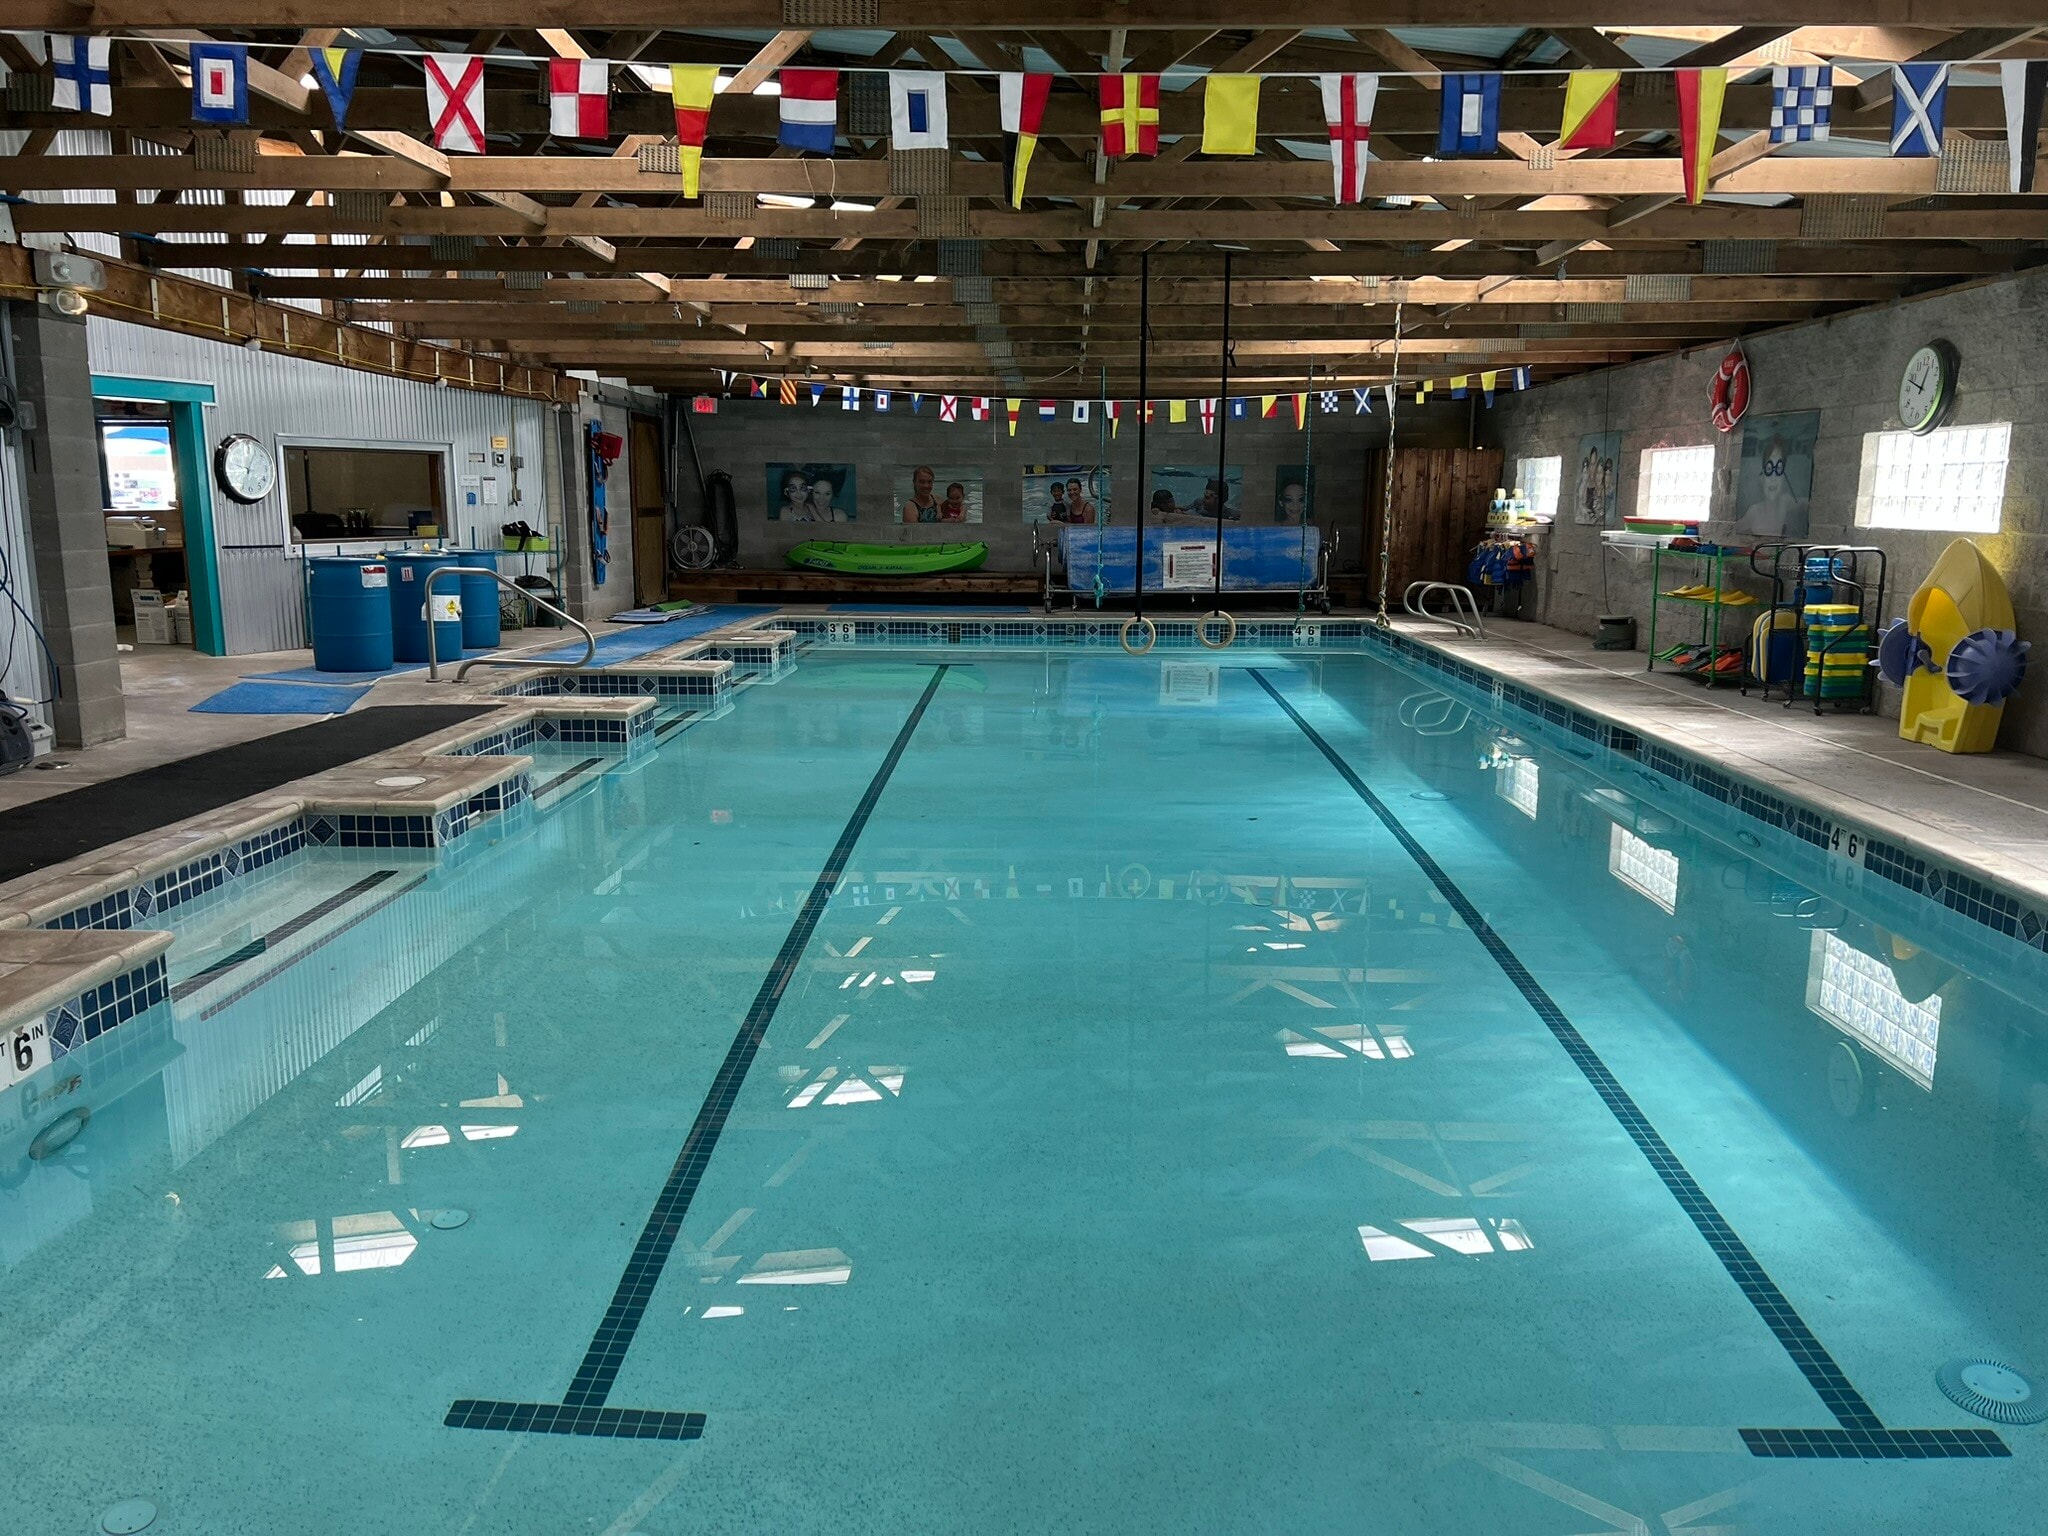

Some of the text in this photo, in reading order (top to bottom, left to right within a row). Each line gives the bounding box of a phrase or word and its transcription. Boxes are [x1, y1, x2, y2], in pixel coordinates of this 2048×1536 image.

[830, 624, 836, 633] 3
[842, 624, 849, 633] 6
[1295, 626, 1302, 635] 4
[1308, 626, 1315, 636] 6
[1831, 828, 1840, 850] 4
[1848, 834, 1857, 858] 6
[14, 1032, 33, 1072] 6
[32, 1024, 43, 1040] IN
